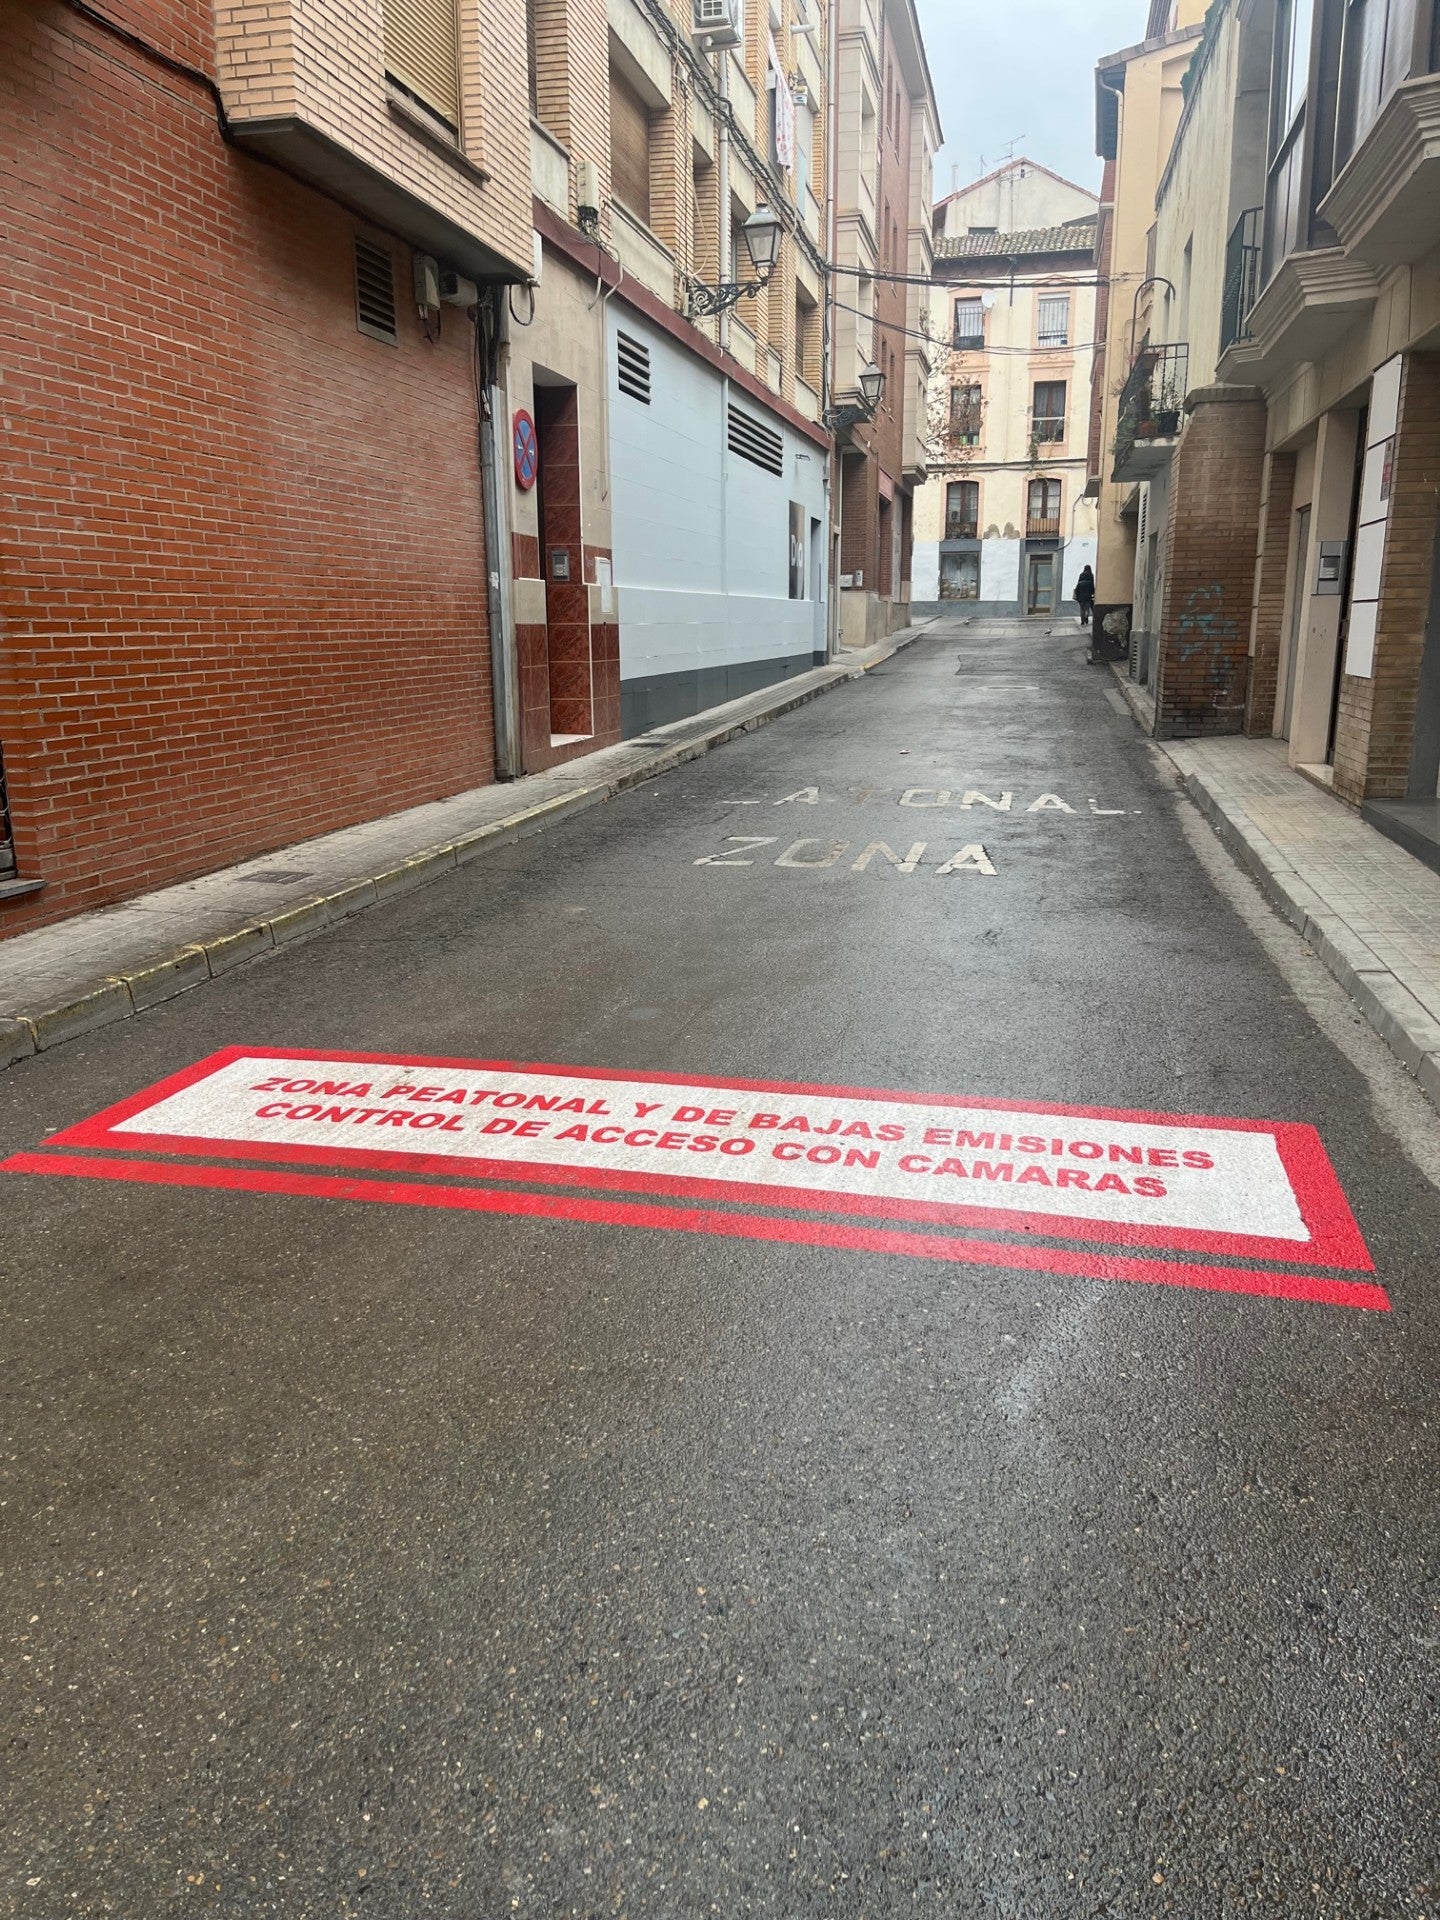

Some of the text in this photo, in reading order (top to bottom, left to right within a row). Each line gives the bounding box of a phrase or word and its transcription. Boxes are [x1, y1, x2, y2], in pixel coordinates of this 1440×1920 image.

[692, 836, 998, 876] ZONA
[250, 1076, 1215, 1170] ZONA PEATONAL Y DE BAJAS EMISIONES
[255, 1101, 1168, 1199] CONTROL DE ACCESO CON CAMARAS
